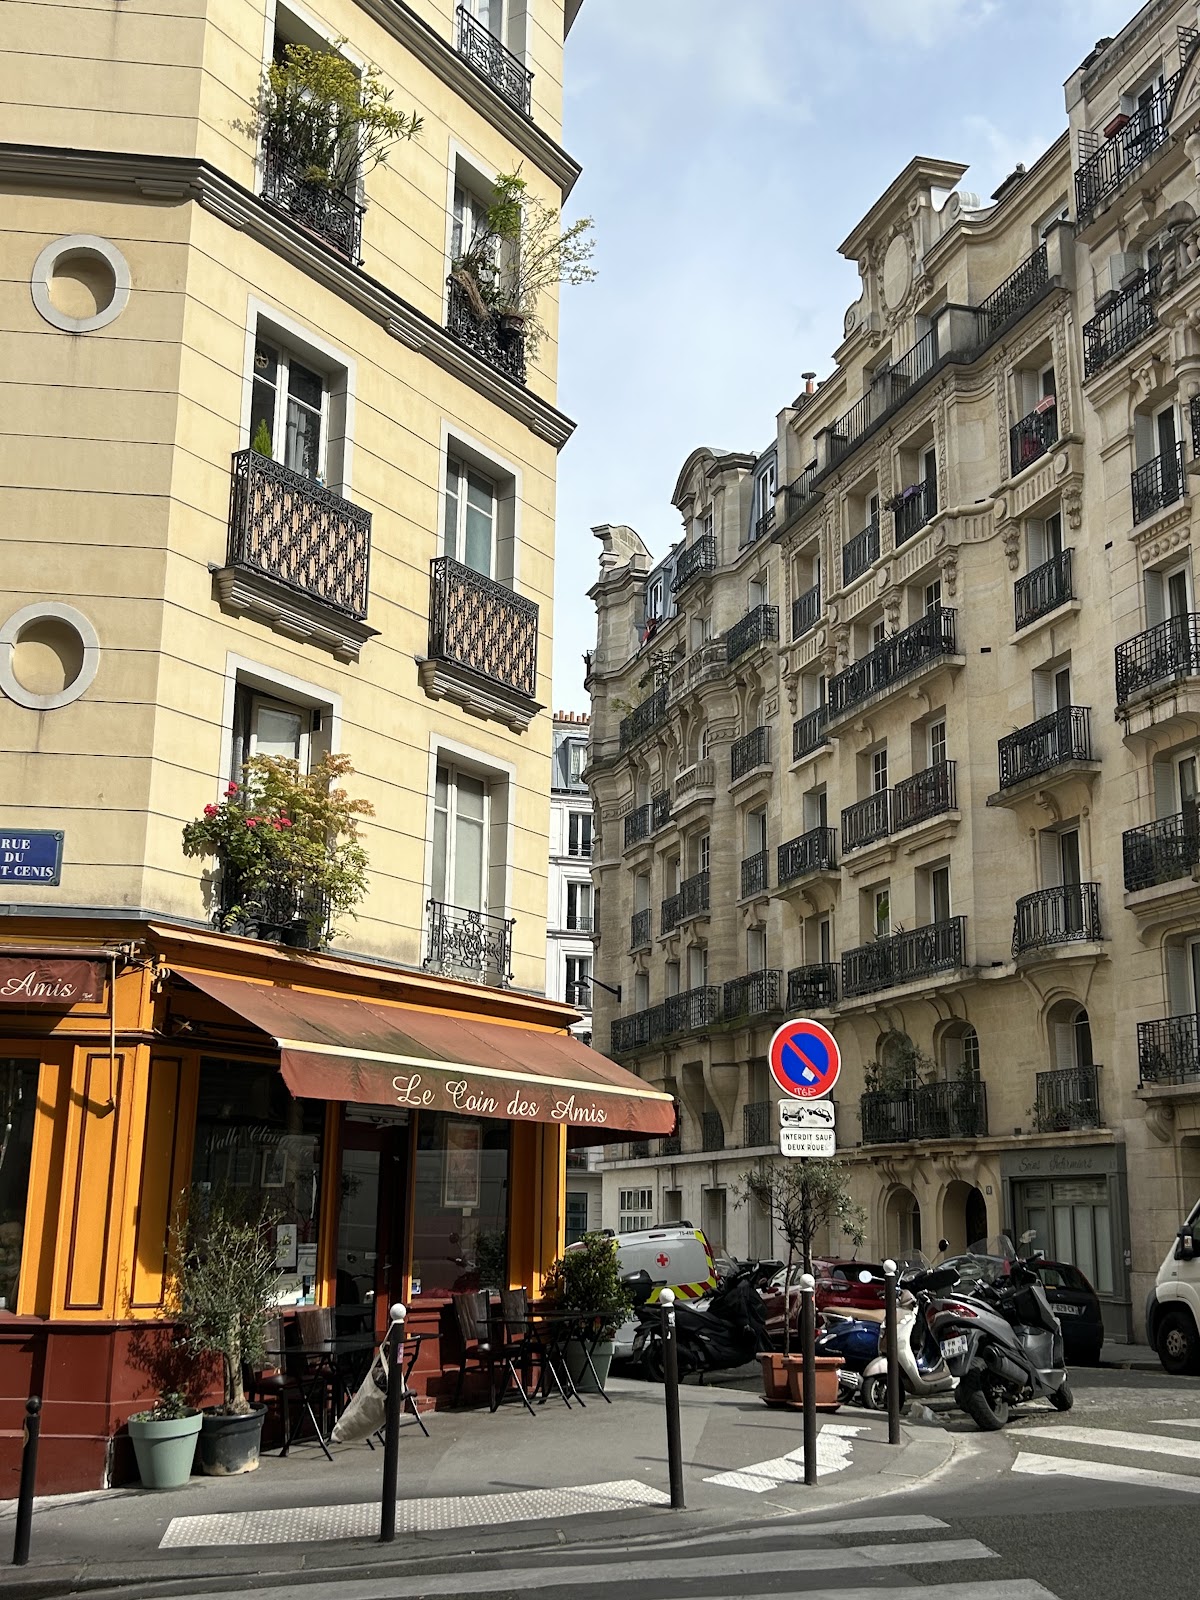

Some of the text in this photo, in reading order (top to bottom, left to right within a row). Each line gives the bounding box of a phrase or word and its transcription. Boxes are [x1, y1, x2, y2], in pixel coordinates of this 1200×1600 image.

[1, 838, 31, 850] RUE
[4, 852, 25, 863] DU
[0, 970, 78, 998] Amis
[392, 1073, 608, 1124] Le Coin des Amis
[783, 1133, 812, 1141] INTERDIT
[787, 1143, 805, 1151] DEUX
